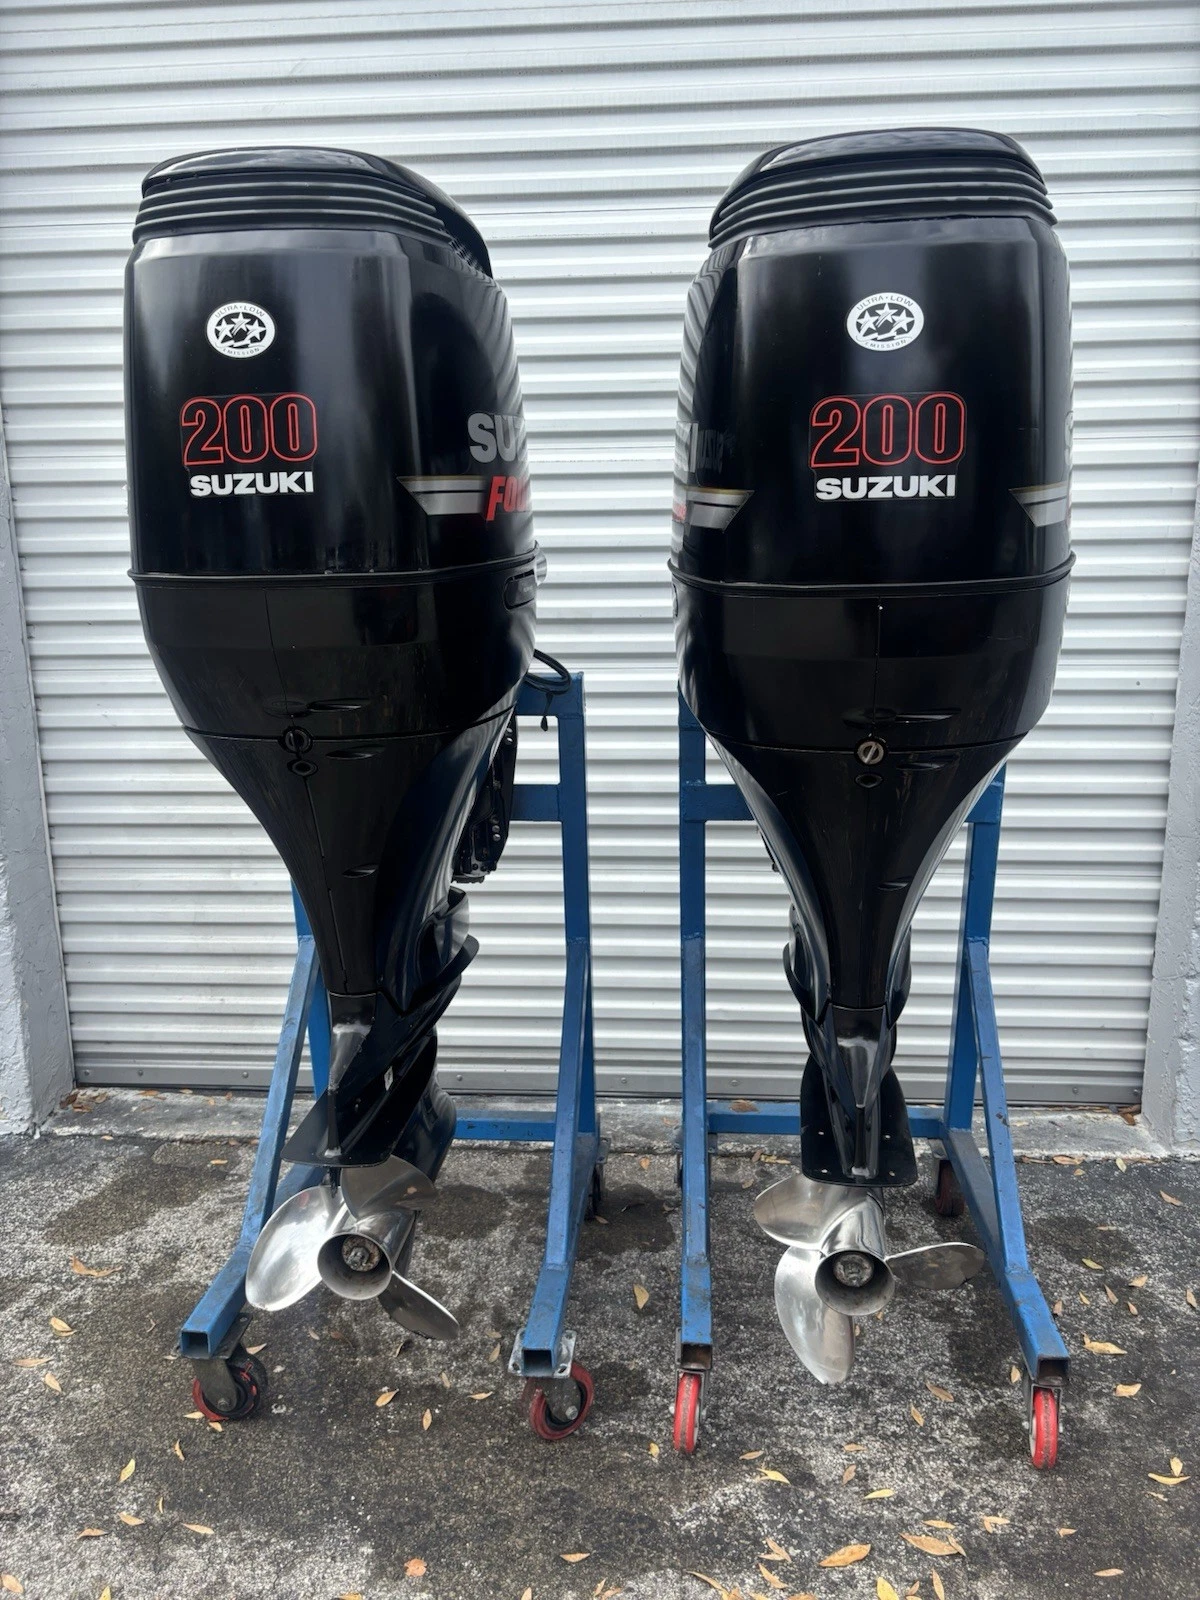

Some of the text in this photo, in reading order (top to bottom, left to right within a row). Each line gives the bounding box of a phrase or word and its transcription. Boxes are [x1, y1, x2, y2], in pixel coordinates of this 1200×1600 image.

[215, 305, 266, 319] ULTRA LOW
[857, 295, 914, 311] ULTRA LOW
[181, 393, 318, 466] 200
[810, 393, 965, 468] 200
[190, 471, 314, 497] SUZUKI
[816, 474, 956, 500] SUZUKI
